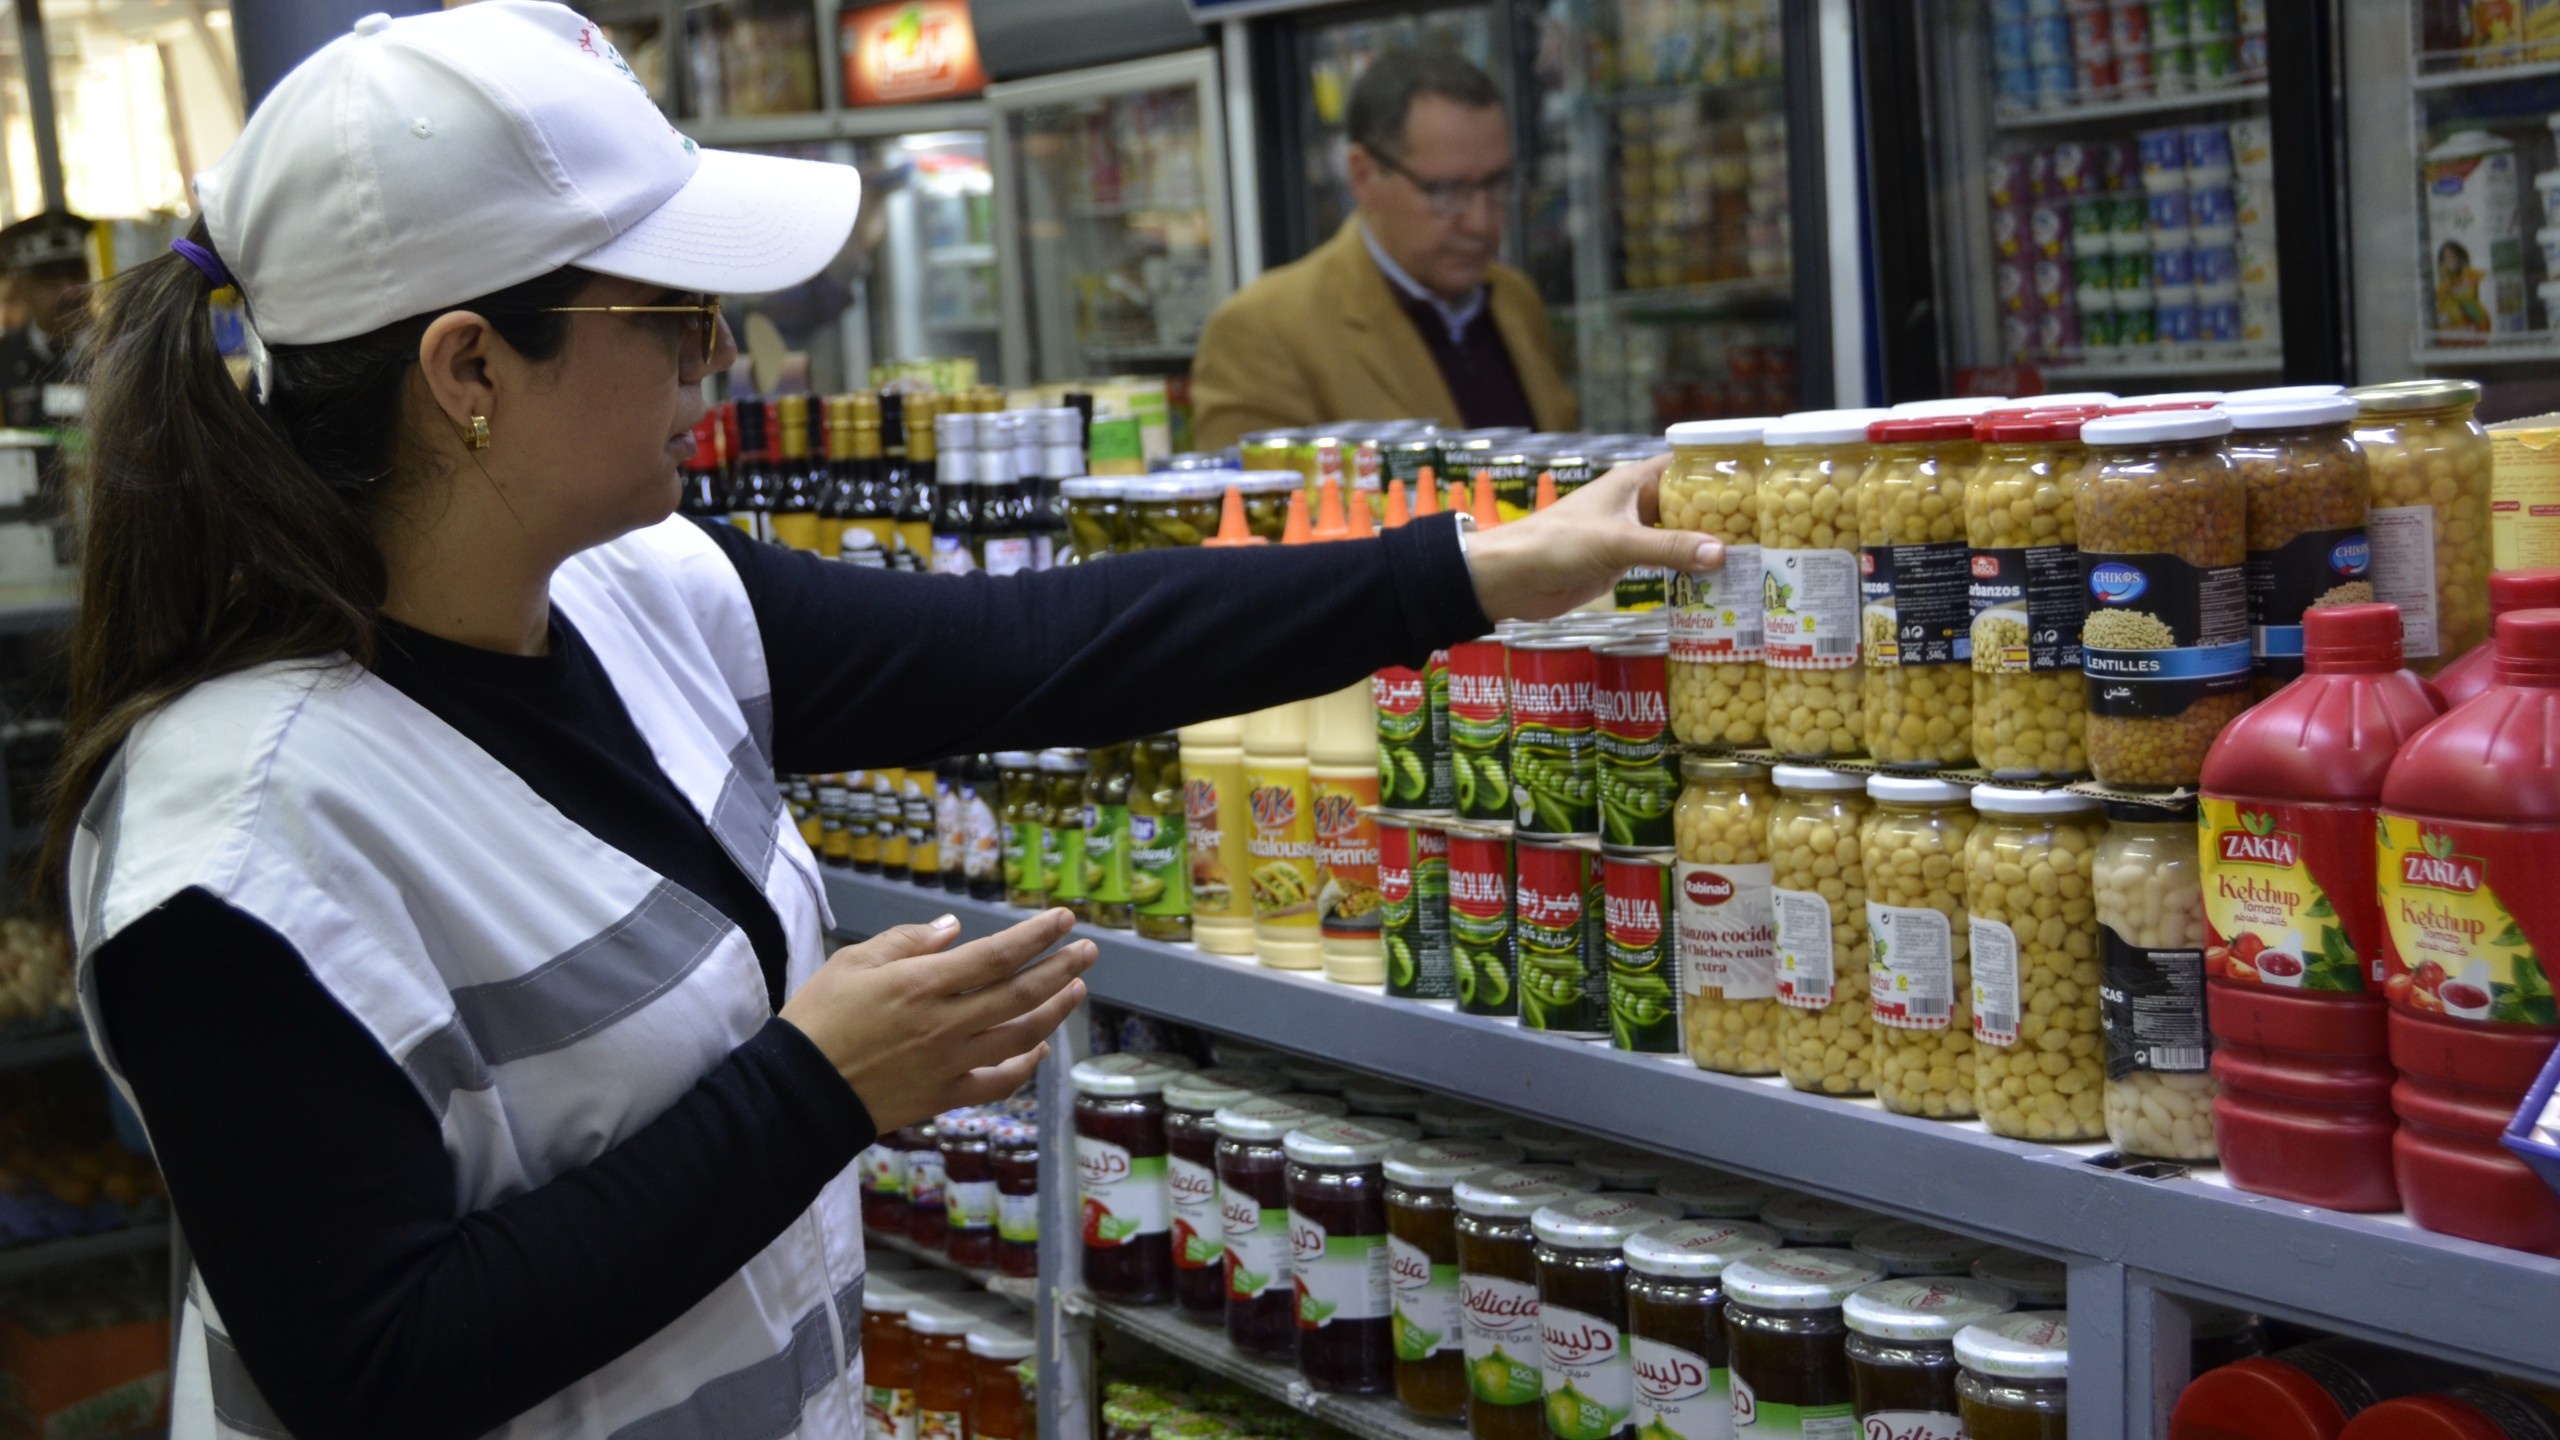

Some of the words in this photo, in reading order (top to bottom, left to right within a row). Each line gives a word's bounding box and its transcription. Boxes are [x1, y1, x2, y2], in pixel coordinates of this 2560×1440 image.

[2093, 571, 2141, 584] CHIKOS
[1678, 613, 1714, 630] Pedriza
[2087, 655, 2160, 672] LENTILLES
[1510, 678, 1594, 713] MABROUK
[2103, 685, 2131, 699] عدس
[2223, 835, 2294, 865] ZAKIA
[2404, 857, 2476, 889] ZAKIA
[1685, 881, 1731, 896] Rabinad
[2218, 874, 2301, 917] Ketchup
[2242, 900, 2282, 915] Tomato
[2400, 897, 2486, 945] Ketchup
[2421, 926, 2461, 945] Tomato
[1695, 962, 1727, 974] extra
[1461, 1281, 1540, 1316] Délicia
